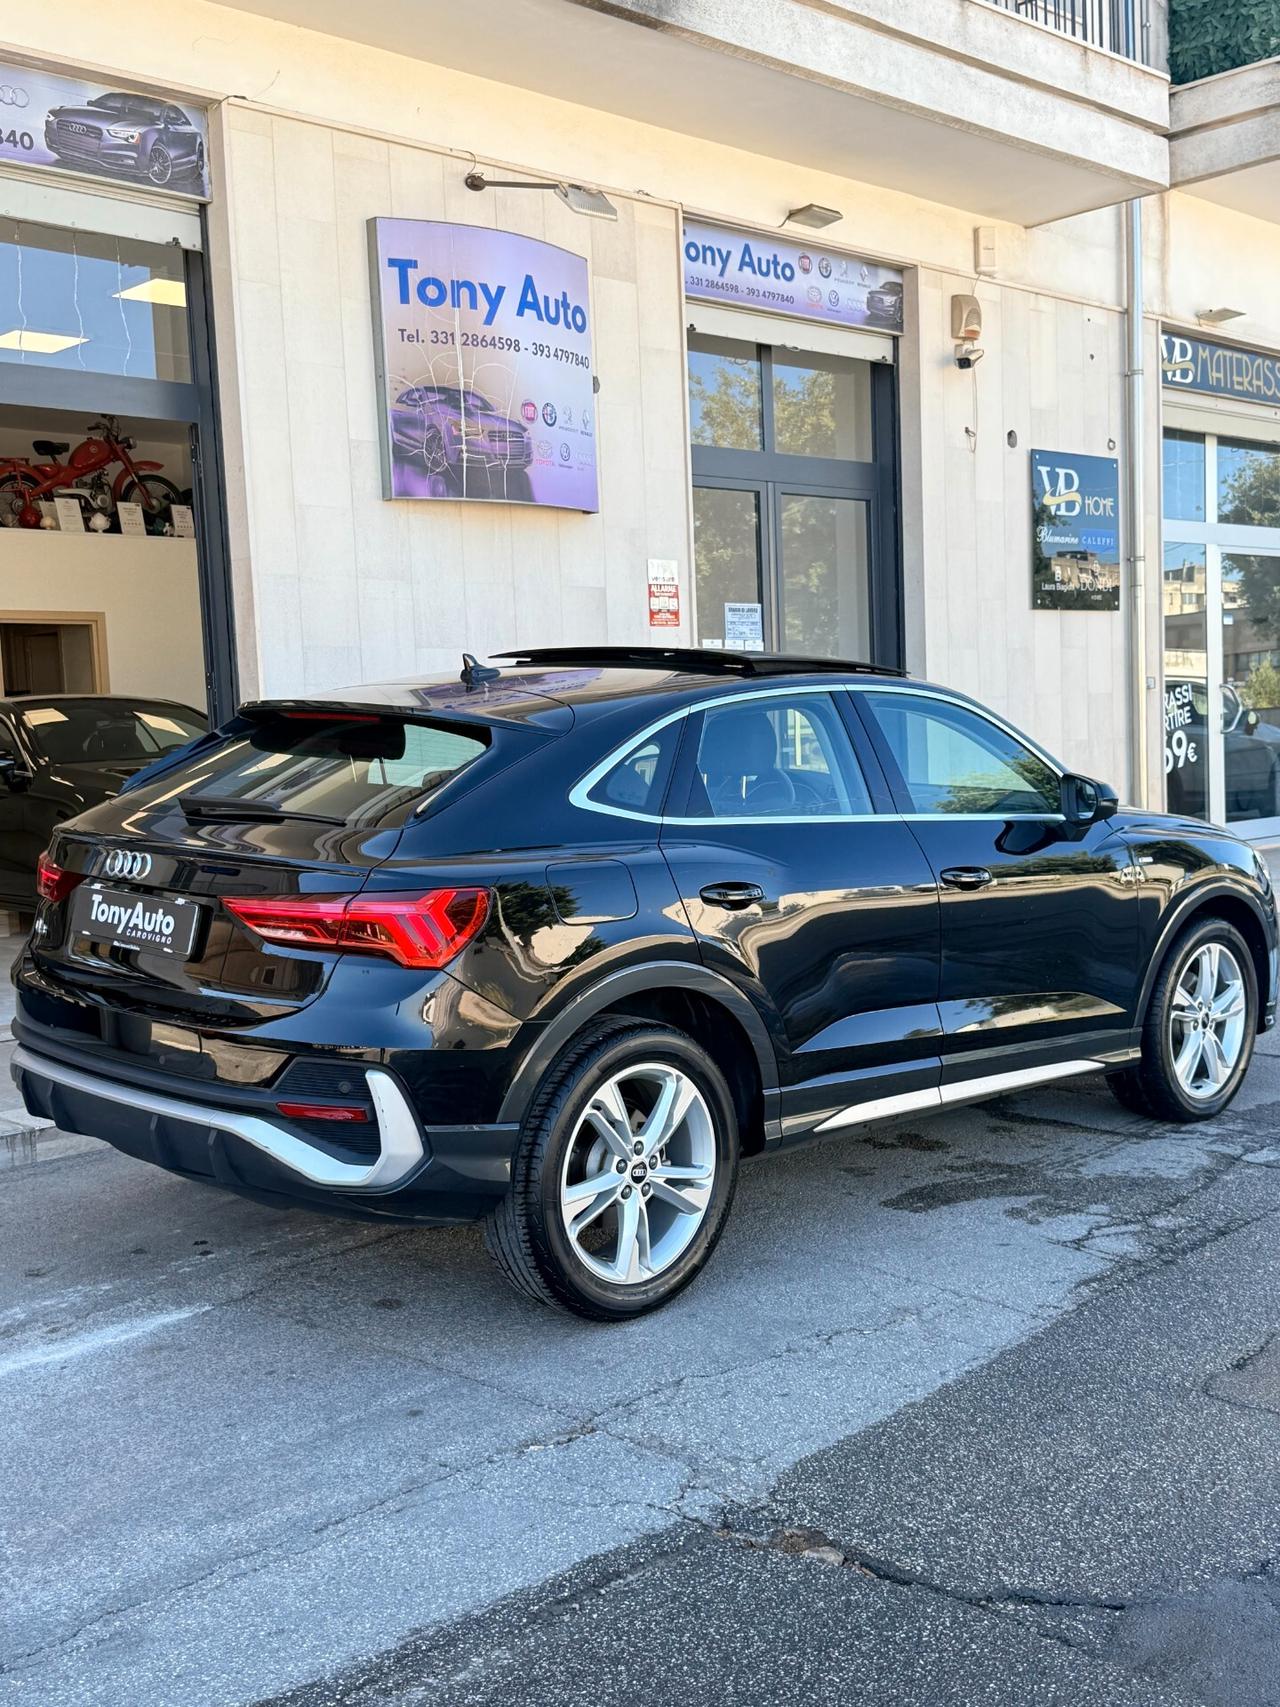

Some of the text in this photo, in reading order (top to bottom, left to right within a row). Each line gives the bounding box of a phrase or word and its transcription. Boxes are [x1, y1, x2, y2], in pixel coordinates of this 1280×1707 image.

[683, 231, 795, 282] ony Auto
[388, 258, 587, 334] Tony Auto
[690, 276, 703, 287] 331
[705, 279, 739, 293] 2864598
[746, 287, 760, 298] 393
[762, 291, 795, 305] 4797840
[398, 328, 425, 344] Tel.
[430, 330, 455, 345] 331
[461, 332, 520, 352] 2864598
[532, 342, 551, 358] 393
[553, 348, 590, 369] 4797840
[1085, 496, 1115, 517] HOME
[1036, 525, 1114, 546] Blumarine CALEFFI
[91, 894, 175, 935] TonyAuto
[126, 928, 173, 945] CAROVIGNO
